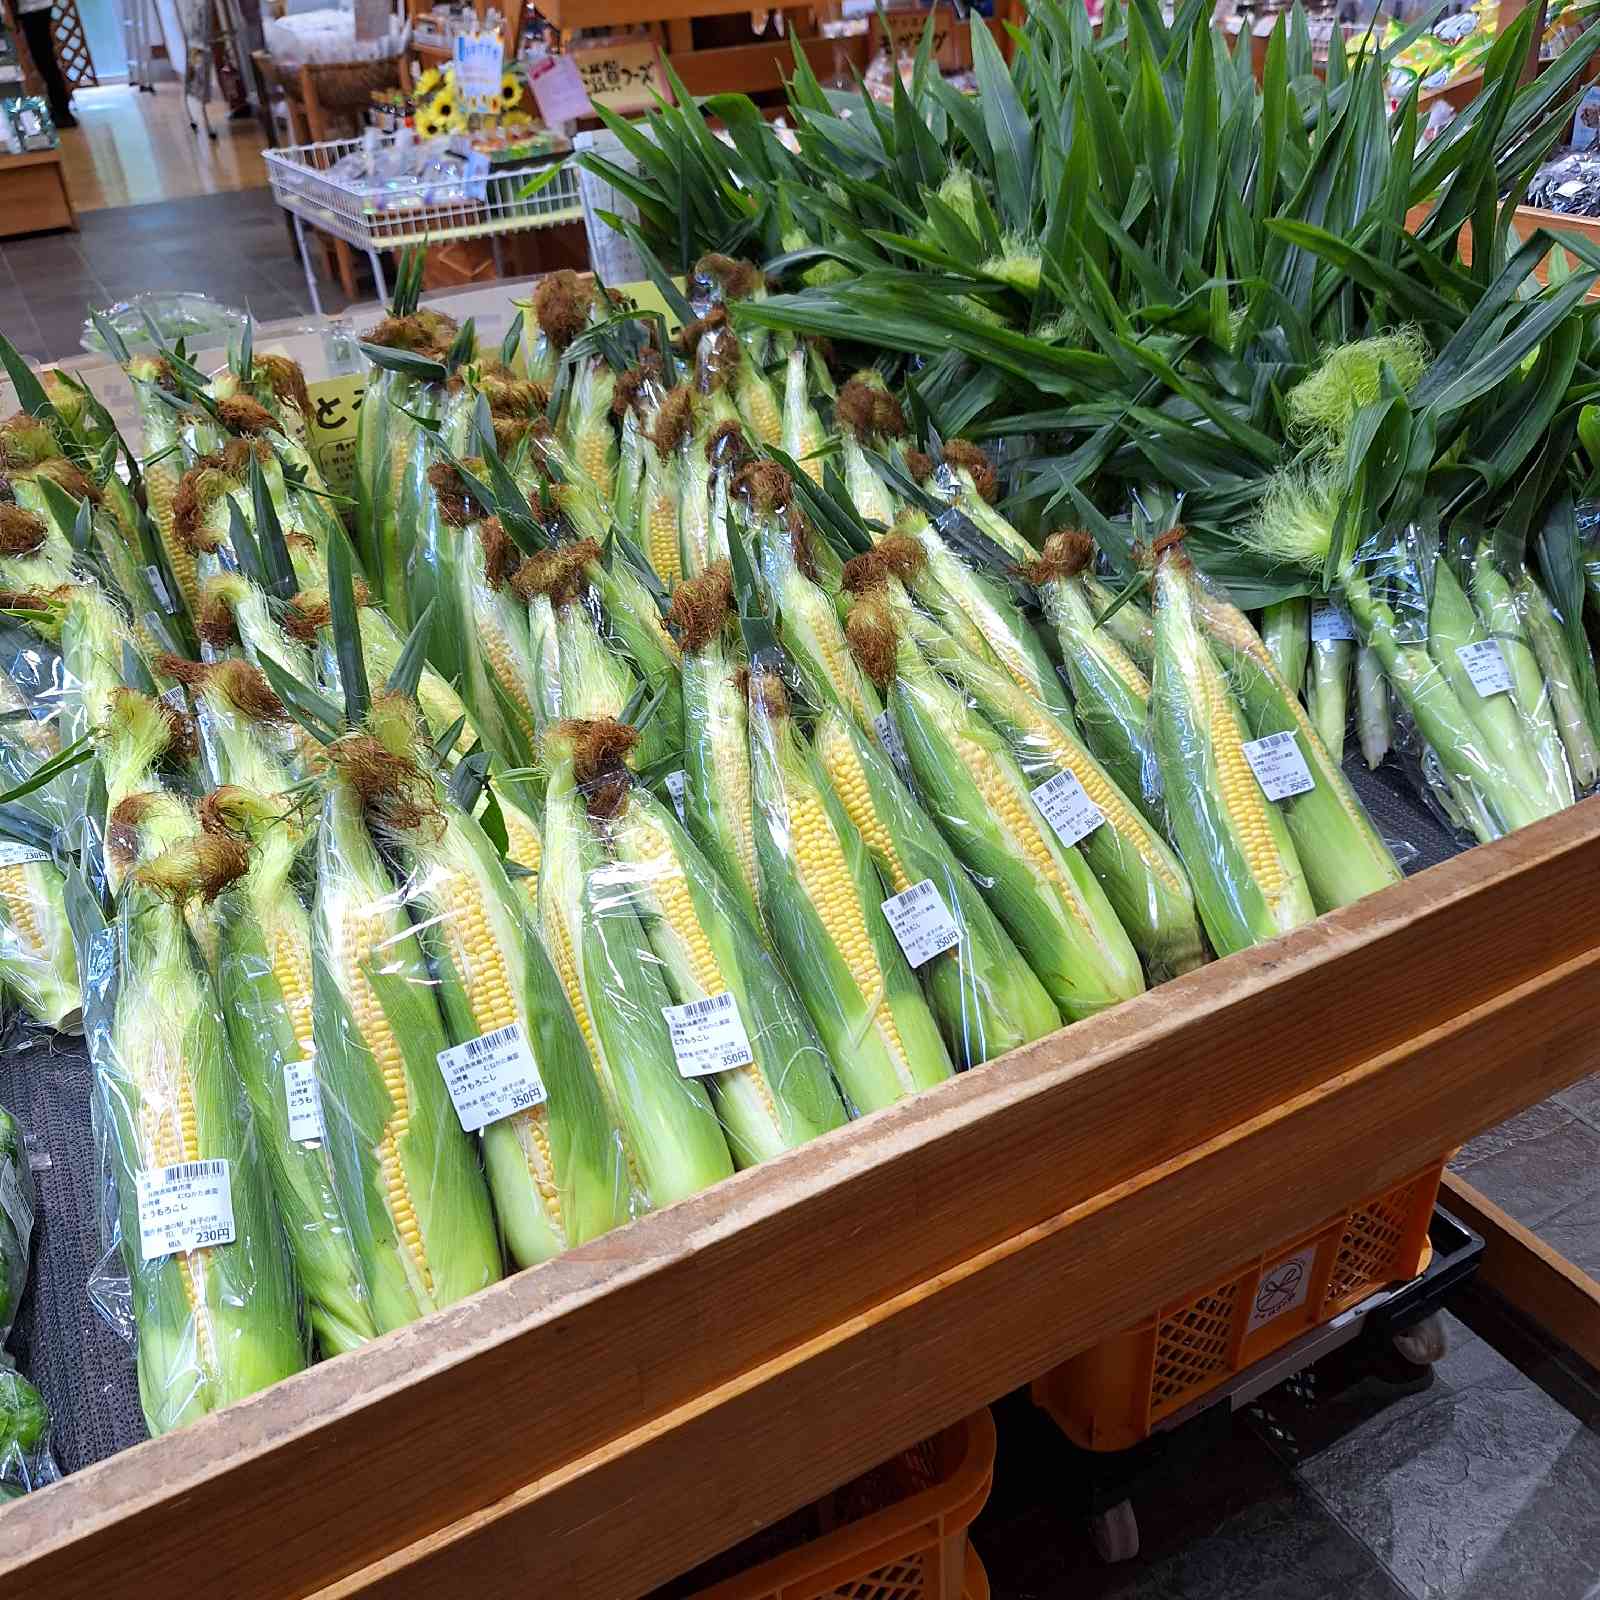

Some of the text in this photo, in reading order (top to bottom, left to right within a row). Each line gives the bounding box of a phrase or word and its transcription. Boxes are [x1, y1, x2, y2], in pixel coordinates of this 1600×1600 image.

[935, 931, 958, 949] 350円
[721, 1049, 749, 1066] 350円
[453, 1072, 497, 1096] とうもろこし
[511, 1087, 542, 1109] 350円
[142, 1203, 188, 1220] とうもろこし
[196, 1228, 230, 1244] 230円
